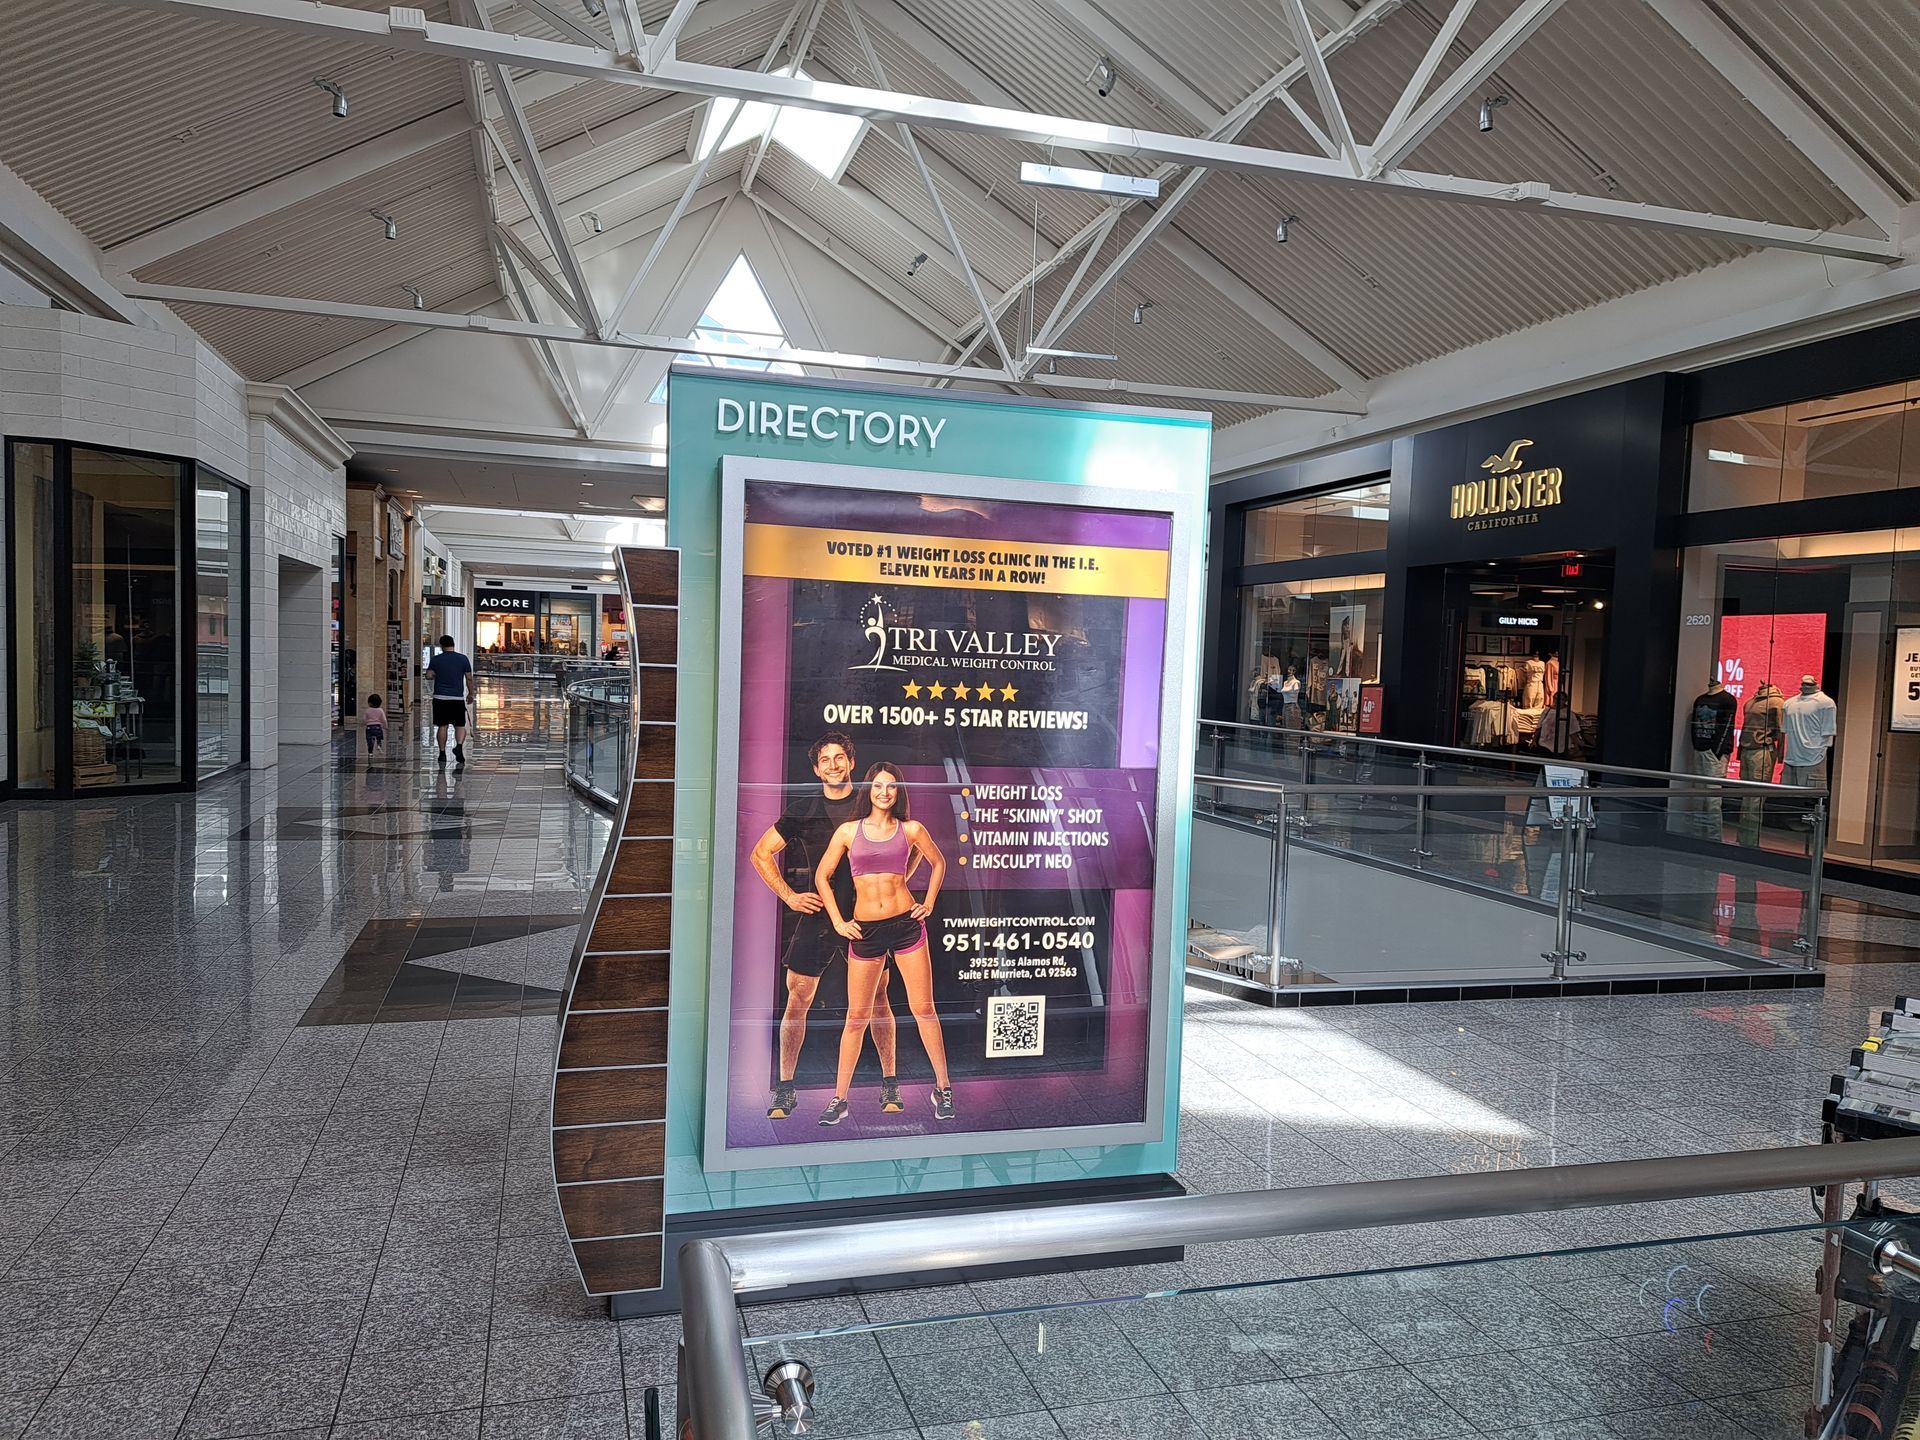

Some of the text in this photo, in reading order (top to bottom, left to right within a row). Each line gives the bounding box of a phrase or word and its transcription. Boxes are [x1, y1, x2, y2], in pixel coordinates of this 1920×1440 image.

[717, 398, 947, 449] DIRECTORY
[1450, 467, 1563, 519] HOLLISTER
[1467, 513, 1539, 531] CALIFORNIA
[826, 541, 1099, 571] VOTED #1 WEIGHT LOSS CLINIC IN THE I.E.
[880, 562, 1046, 584] ELEVEN YEARS IN A ROW!
[480, 598, 529, 608] ADORE
[1498, 617, 1538, 626] GILLY HICKS
[1686, 615, 1711, 626] 2620
[888, 627, 1063, 657] TRI VALLEY
[893, 655, 1056, 671] MEDICAL WEIGHT CONTROL
[1904, 652, 1920, 663] JE
[823, 703, 1089, 730] OVER 1500+ 5 STAR REVIEWS!
[974, 785, 1063, 801] WEIGHT LOSS
[974, 808, 999, 823] THE
[1067, 809, 1103, 824] SHOT
[973, 831, 1110, 847] VITAMIN INJECTIONS
[972, 854, 1073, 869] EMSCULPT NEO
[943, 916, 1096, 928] TVMWEIGHTCONTROL.COM
[942, 931, 1095, 951] 951-461-0540
[969, 957, 999, 967] 39525
[1000, 957, 1016, 967] Los
[1017, 956, 1051, 966] Alamos
[958, 967, 1078, 980] Suite E Murrieta, CA 92563
